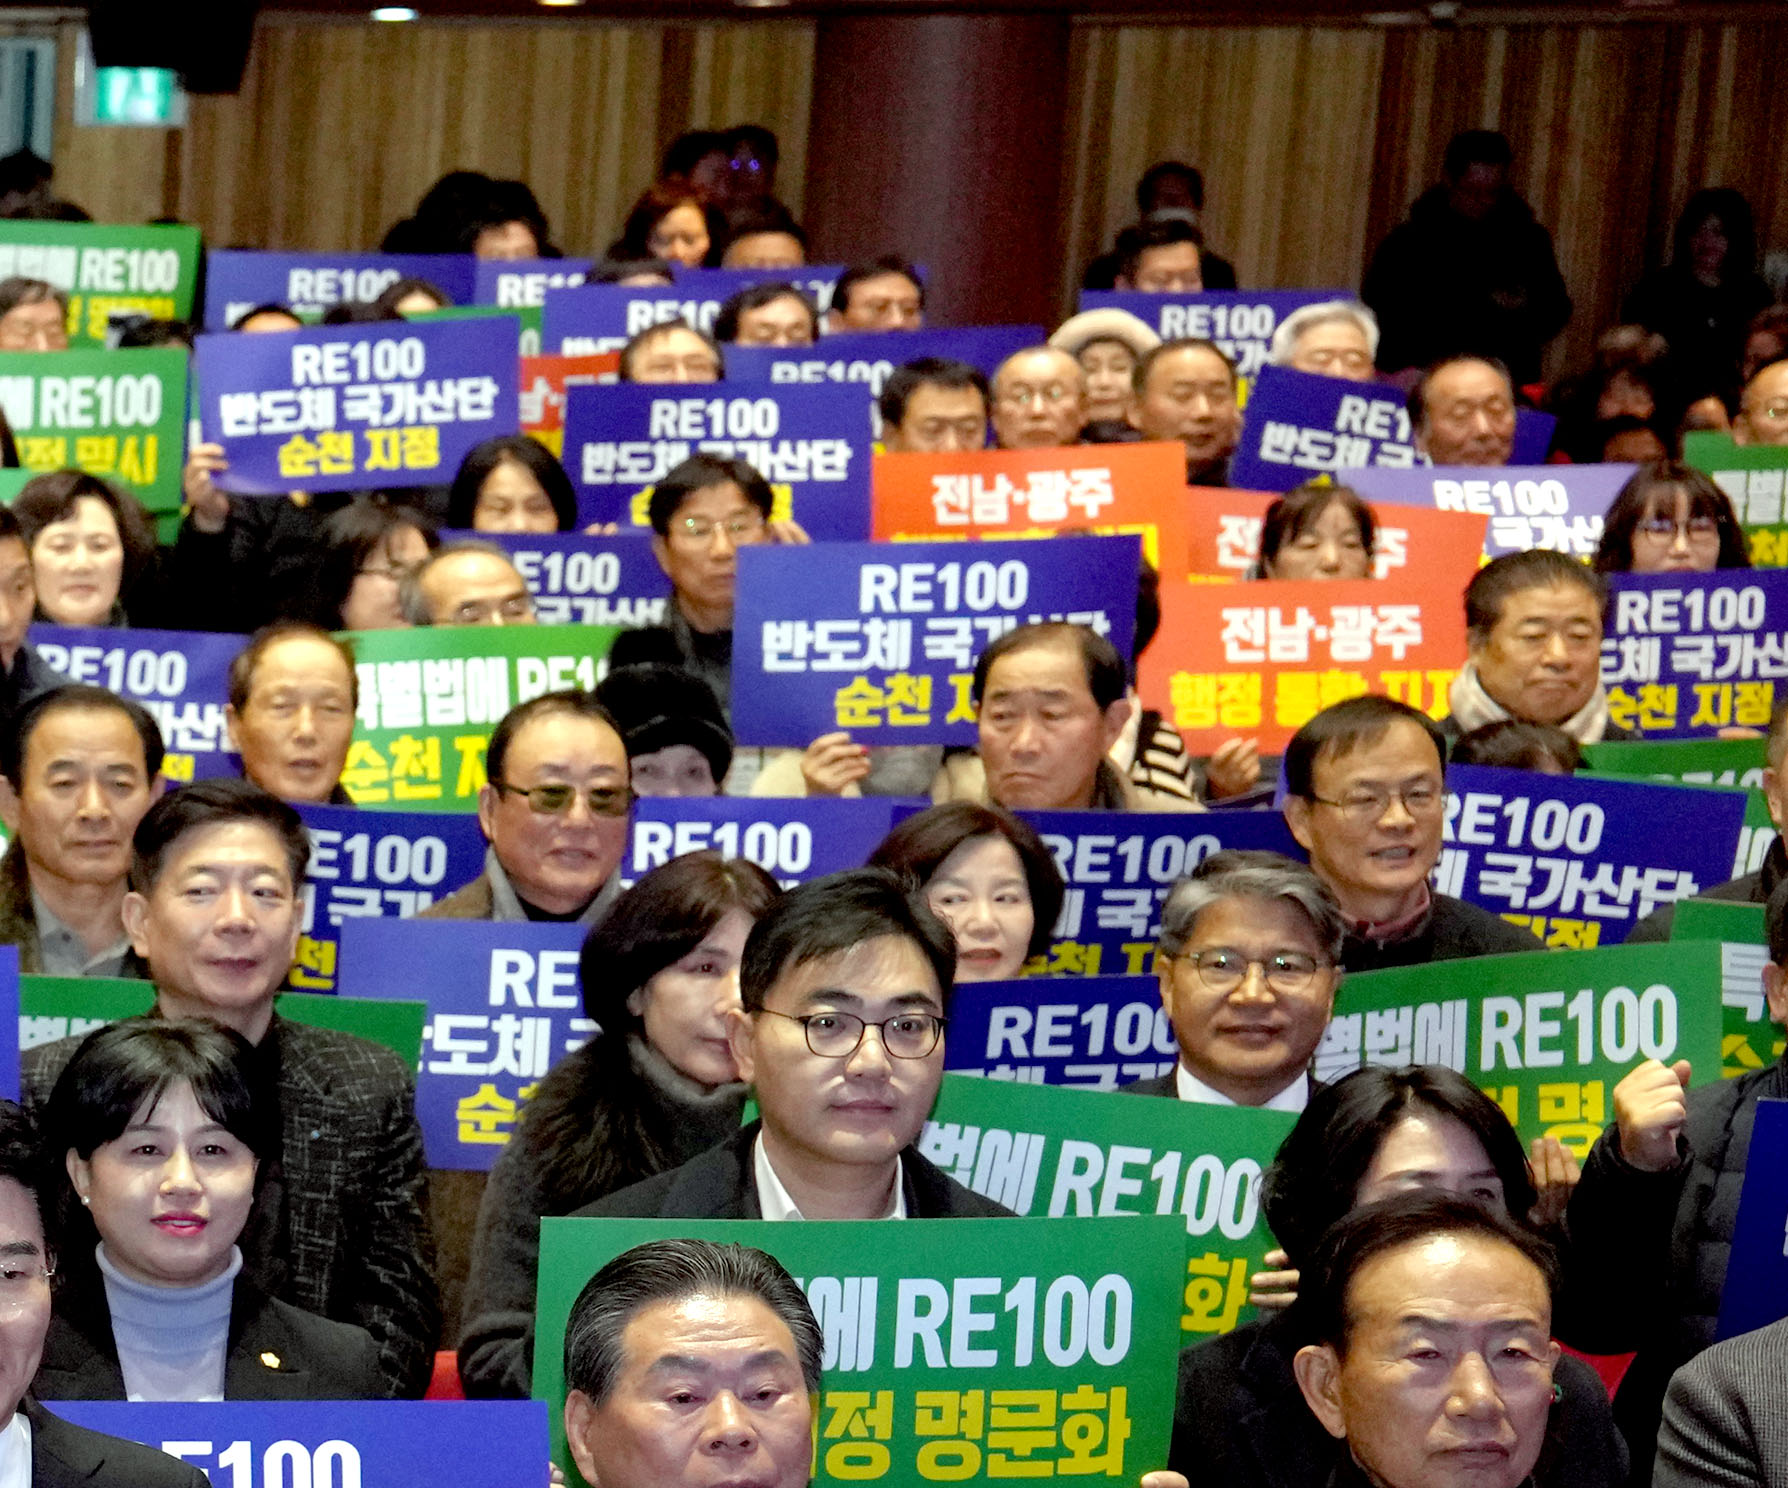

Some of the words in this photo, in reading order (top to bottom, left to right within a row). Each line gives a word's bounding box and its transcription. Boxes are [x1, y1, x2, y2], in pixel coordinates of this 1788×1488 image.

[80, 249, 180, 293] RE100
[288, 267, 399, 305] RE100
[1159, 303, 1275, 340] RE100
[291, 338, 424, 385] RE100
[40, 375, 162, 428] RE100
[219, 389, 336, 435] 반도체
[344, 382, 500, 426] 국가산단
[649, 399, 780, 438] RE100
[279, 430, 359, 476] 순천
[364, 426, 440, 471] 지정
[582, 441, 689, 483] 반도체
[1259, 421, 1370, 470] 반도체
[932, 468, 1113, 525] 전남·광주
[1432, 480, 1569, 516] RE100
[859, 560, 1029, 613] RE100
[1616, 586, 1766, 634] RE100
[762, 619, 912, 672] 반도체
[1221, 606, 1422, 662] 전남·광주
[835, 672, 932, 727] 순천
[1170, 670, 1262, 729] 행정
[1608, 683, 1678, 729] 순천
[1690, 681, 1774, 727] 지정
[342, 736, 442, 795] 순천
[633, 820, 812, 874] RE100
[1479, 852, 1699, 920] 국가산단
[1482, 984, 1678, 1068] RE100
[1050, 1142, 1265, 1244] RE100
[893, 1271, 1133, 1369] RE100
[812, 1388, 897, 1483] 정
[916, 1382, 1130, 1483] 명문화
